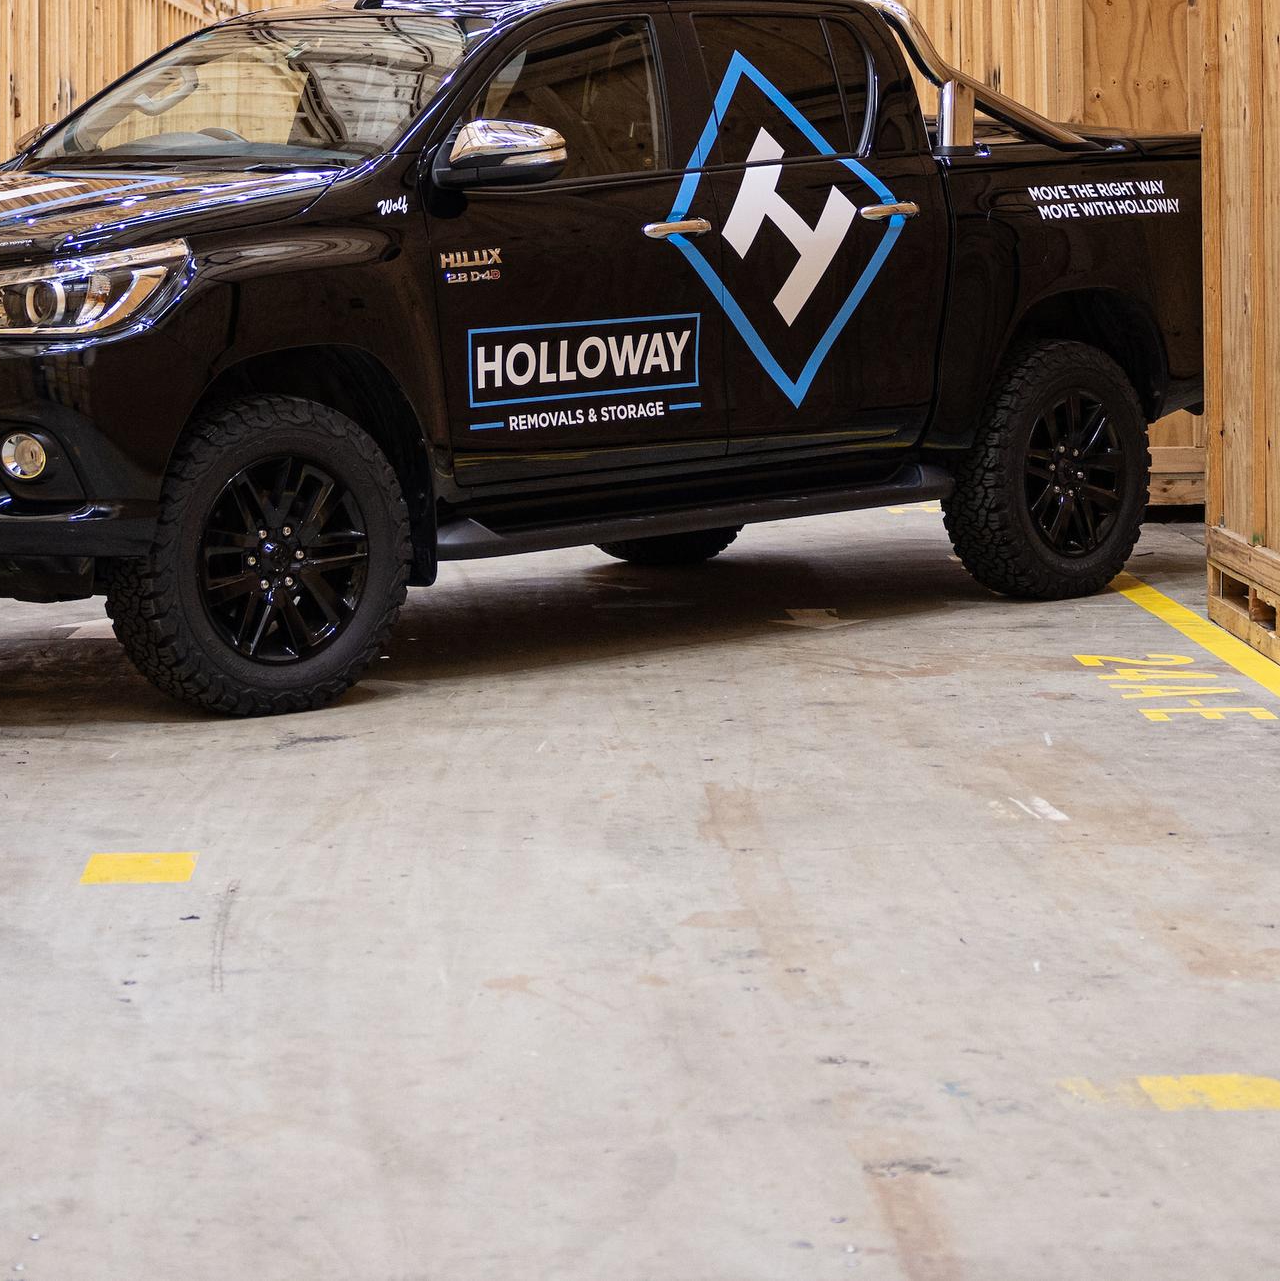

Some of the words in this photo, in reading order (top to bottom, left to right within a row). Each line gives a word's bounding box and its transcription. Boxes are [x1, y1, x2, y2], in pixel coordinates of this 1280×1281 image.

[1028, 186, 1070, 201] MOVE
[1068, 183, 1098, 198] THE
[1096, 182, 1136, 197] RIGHT
[1135, 180, 1165, 195] WAY
[376, 194, 409, 216] Wolf
[1037, 203, 1080, 220] MOVE
[1078, 200, 1117, 217] WITH
[1115, 198, 1180, 215] HOLLOWAY
[440, 247, 502, 269] HILUX
[477, 330, 691, 389] HOLLOWAY
[508, 409, 585, 431] REMOVALS
[588, 406, 597, 423] &
[600, 401, 665, 421] STORAGE
